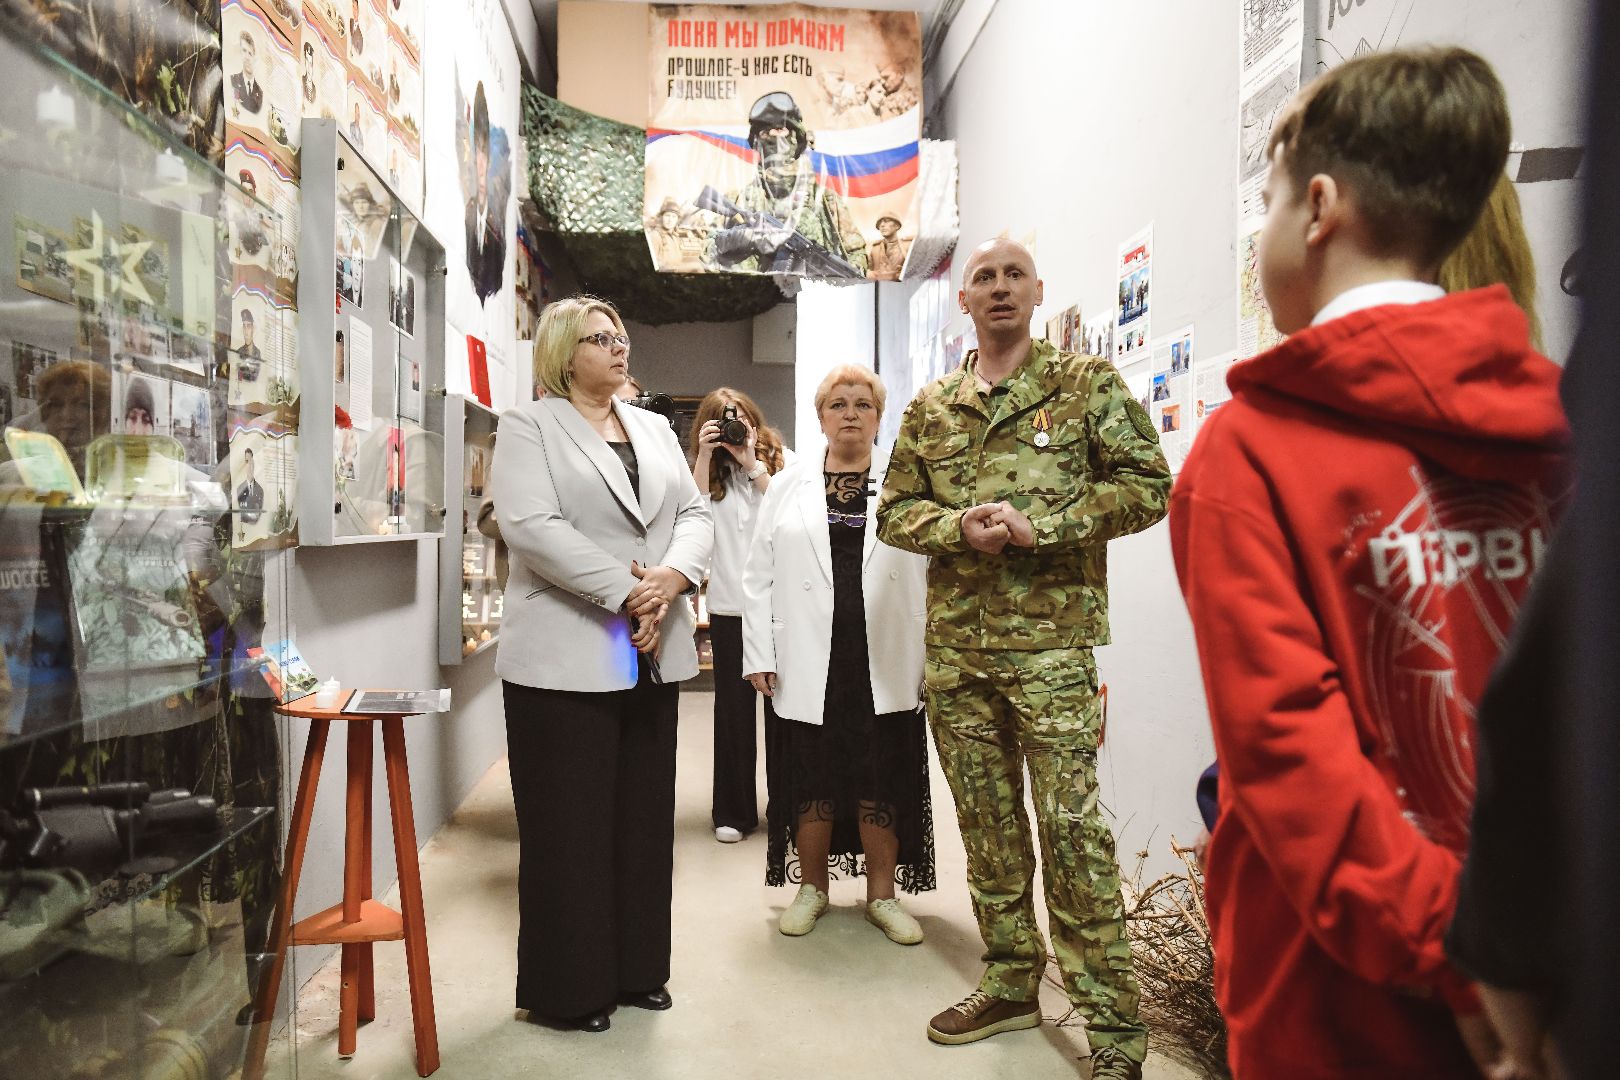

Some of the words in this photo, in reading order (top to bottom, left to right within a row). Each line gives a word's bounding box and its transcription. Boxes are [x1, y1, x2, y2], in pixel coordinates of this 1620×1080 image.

[668, 20, 718, 48] ПОКА
[725, 20, 758, 48] МЫ
[754, 56, 779, 76] НАС
[783, 54, 812, 77] ЕСТЬ
